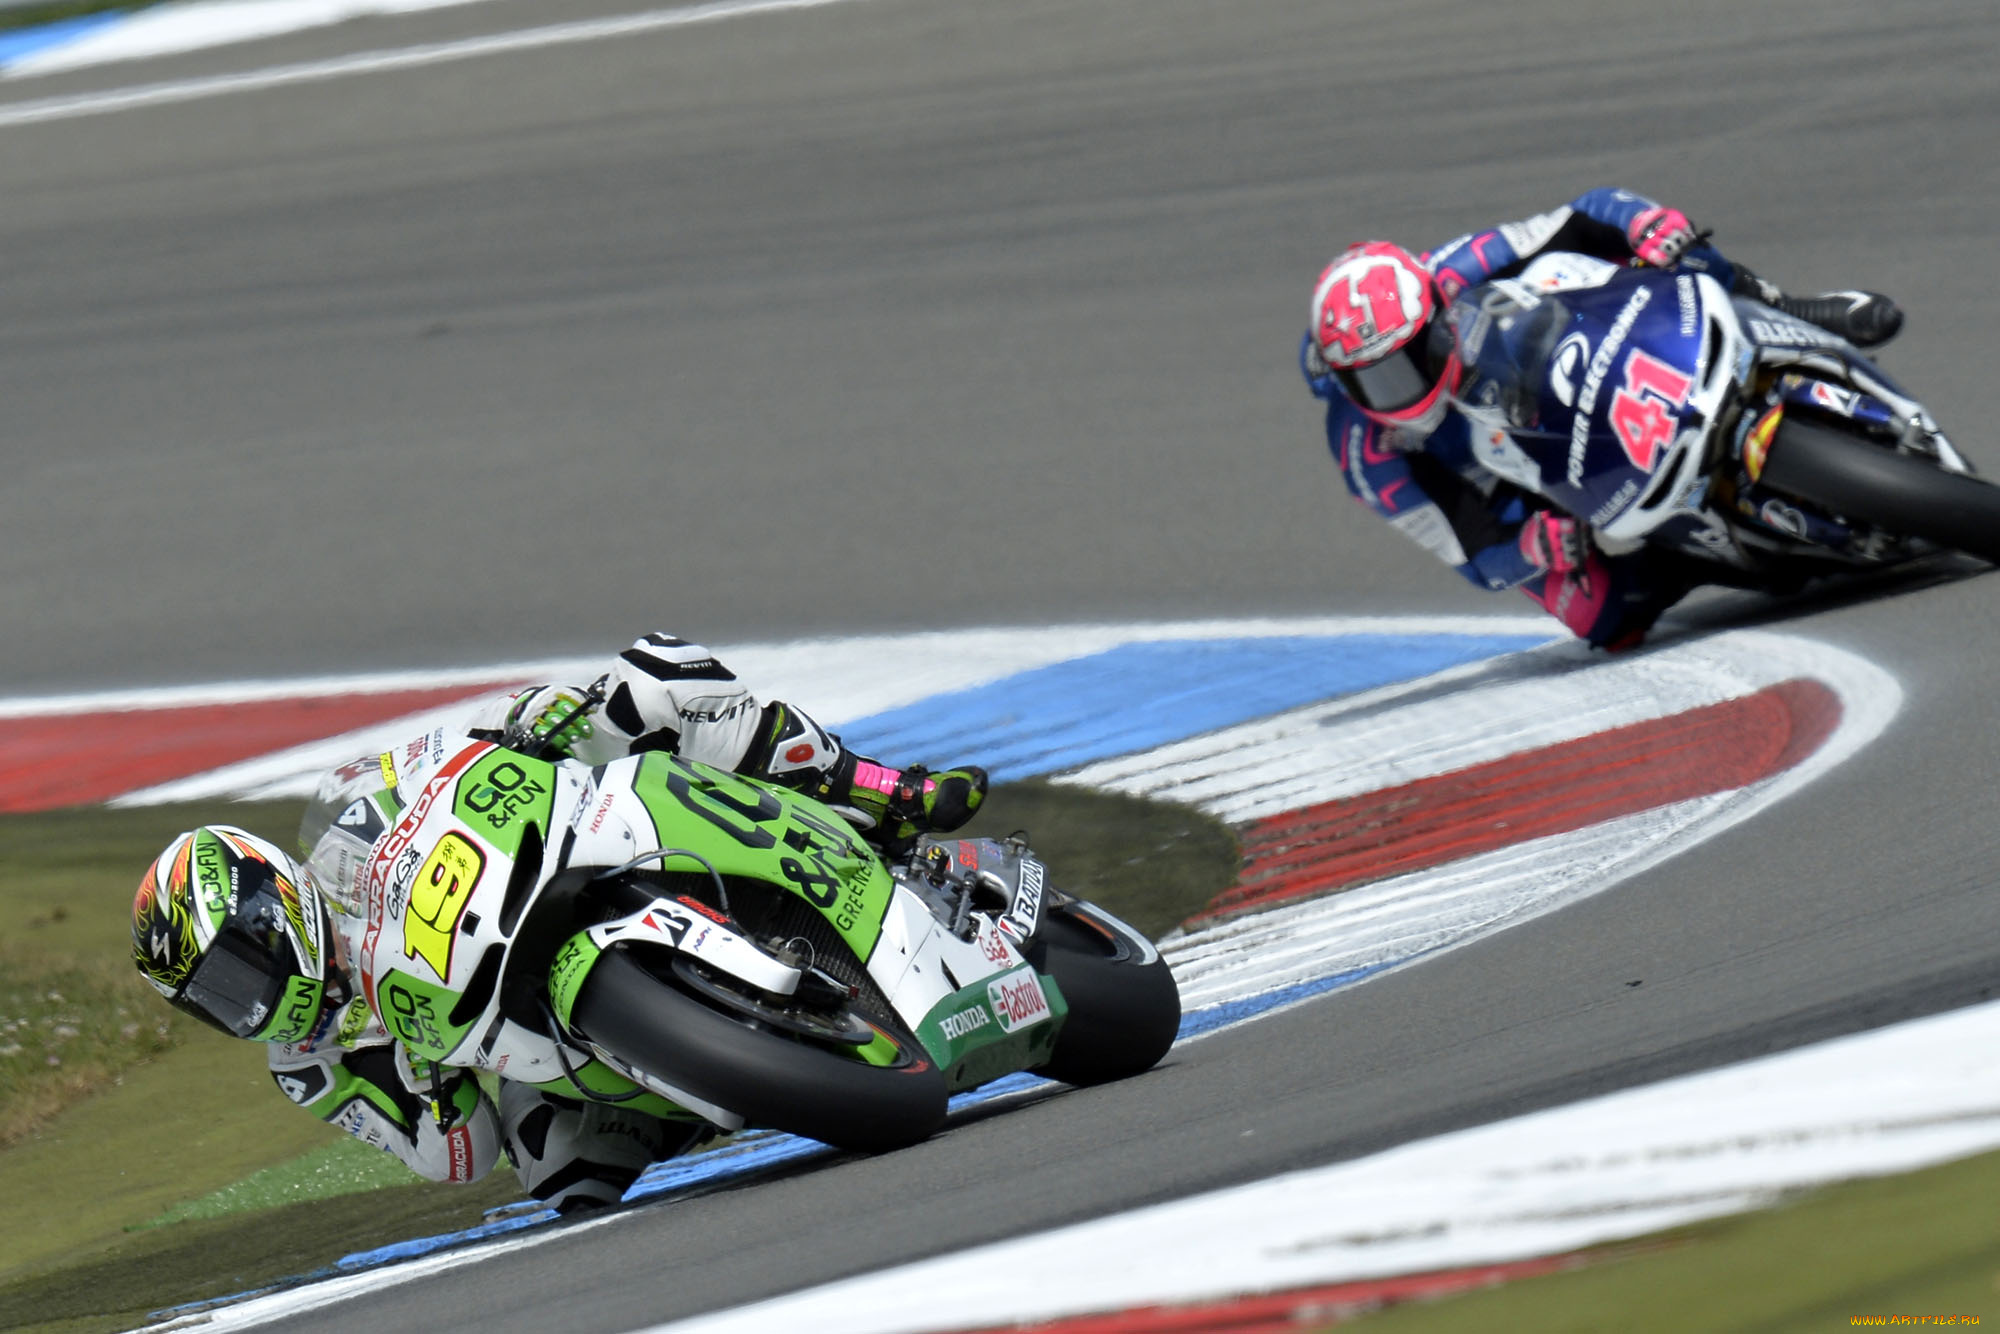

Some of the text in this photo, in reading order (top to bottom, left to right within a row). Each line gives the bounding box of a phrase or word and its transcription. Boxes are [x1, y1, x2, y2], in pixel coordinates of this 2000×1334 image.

[1567, 284, 1653, 489] POWER ELECTRONICS
[1609, 346, 1693, 475] 41
[465, 761, 526, 814] GO
[487, 779, 547, 829] &FUN
[589, 793, 615, 835] HONDA
[360, 775, 452, 979] BARRACUDA
[361, 833, 389, 893] HONDA
[404, 829, 488, 985] 19
[389, 984, 425, 1045] GO
[417, 994, 446, 1050] &FUN
[938, 1004, 991, 1041] HONDA
[1001, 973, 1046, 1024] Castrol
